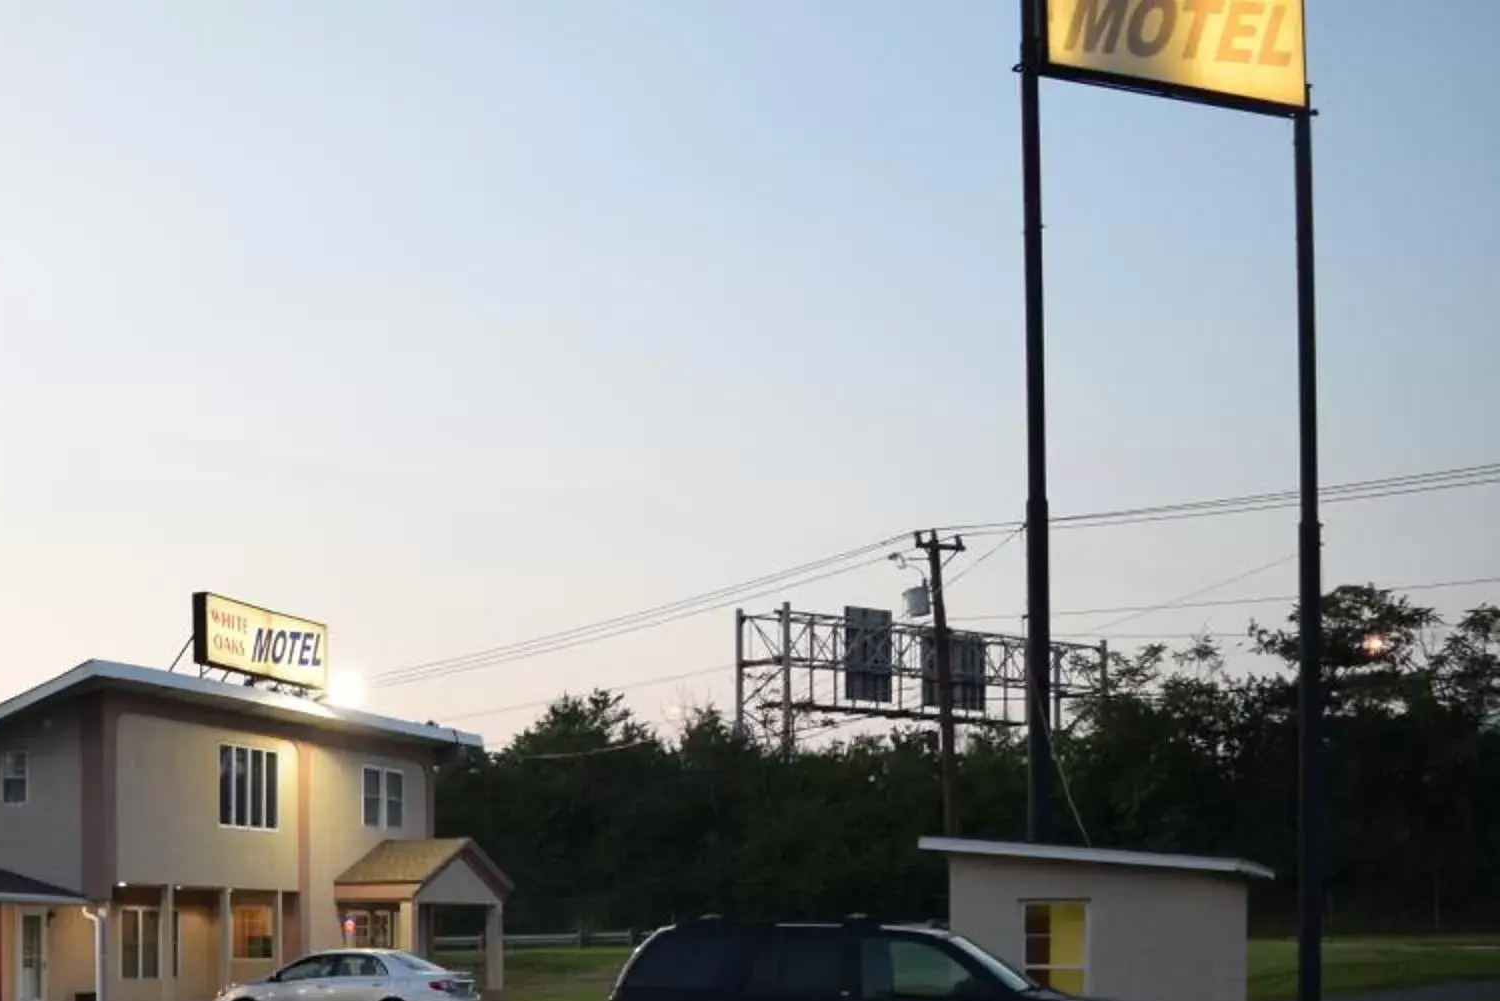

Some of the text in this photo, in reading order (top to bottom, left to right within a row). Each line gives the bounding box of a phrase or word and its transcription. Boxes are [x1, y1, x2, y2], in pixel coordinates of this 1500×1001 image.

[1064, 0, 1292, 65] MOTEL
[211, 609, 248, 633] WHITE
[214, 635, 245, 656] OAKS
[252, 628, 321, 666] MOTEL
